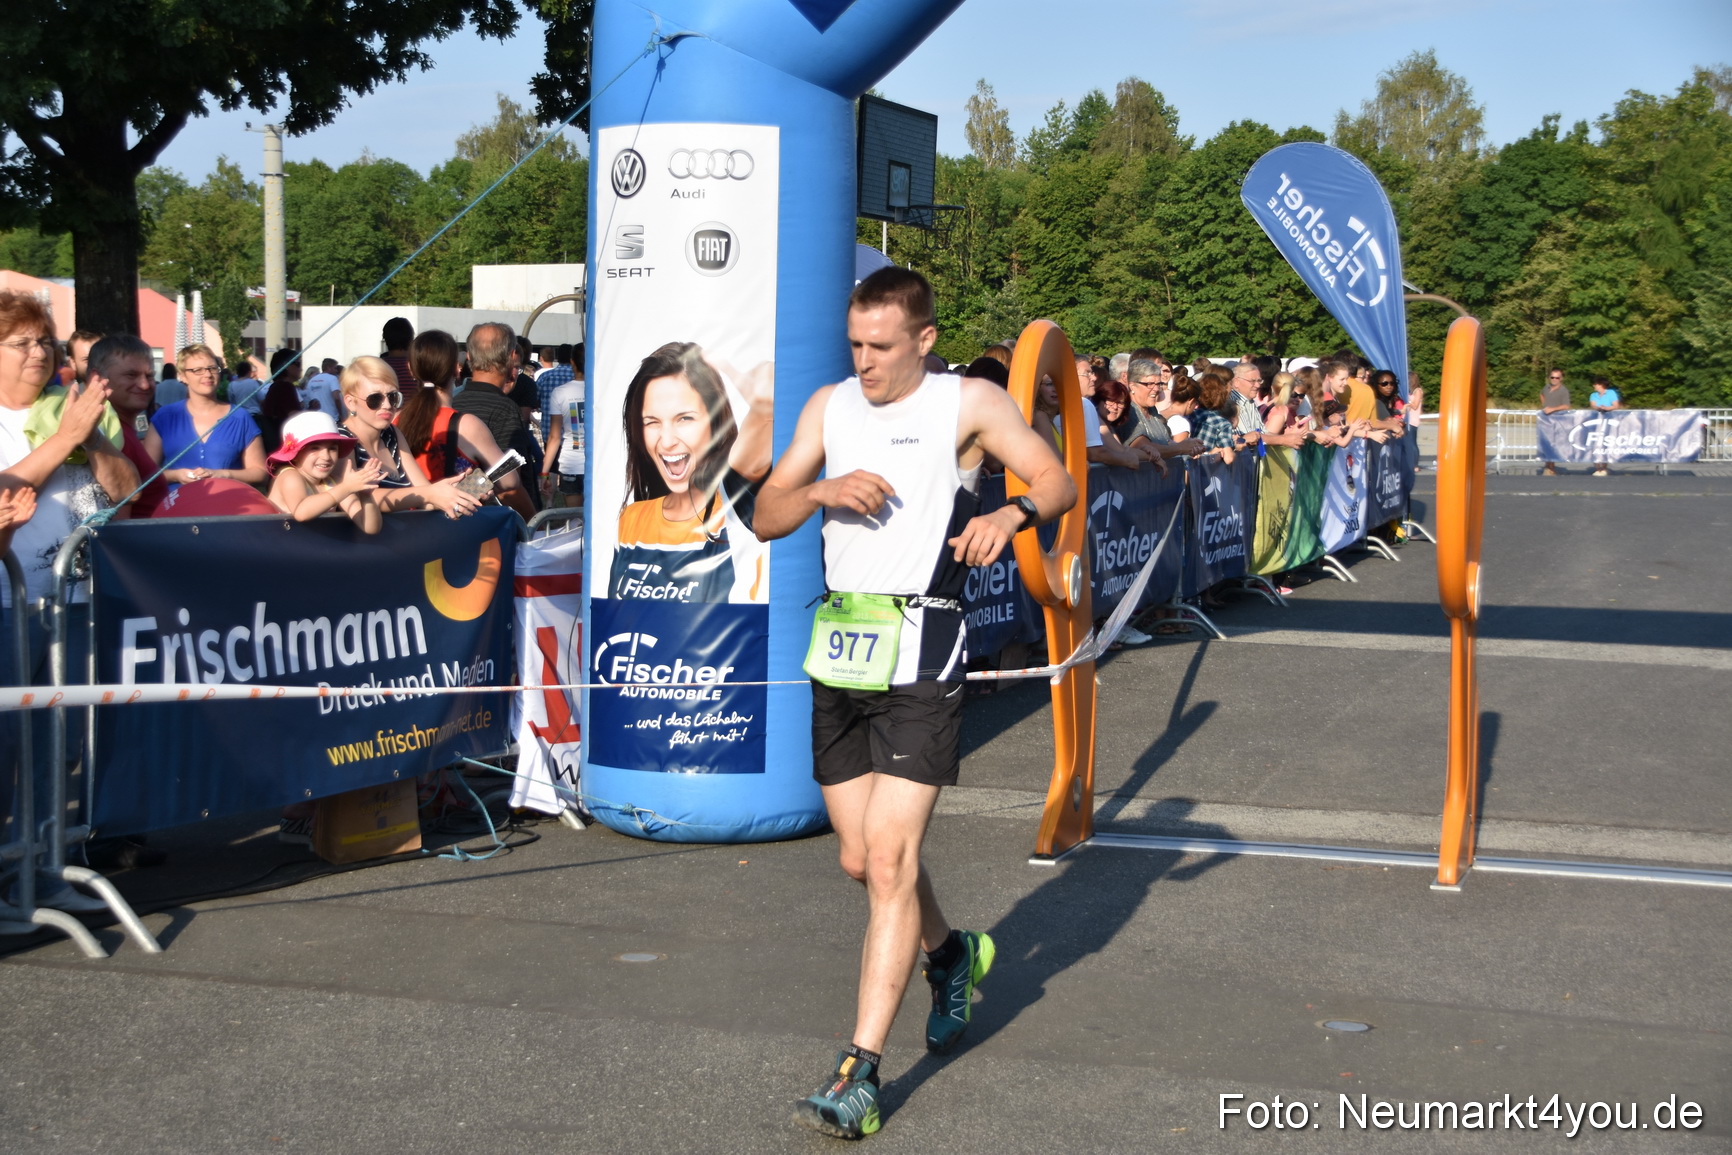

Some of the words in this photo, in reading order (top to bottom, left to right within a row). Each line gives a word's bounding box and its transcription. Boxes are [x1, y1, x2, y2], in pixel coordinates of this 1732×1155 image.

[670, 188, 706, 199] Audi
[698, 237, 728, 262] FIAT
[607, 267, 655, 278] SEAT
[891, 437, 919, 445] Stefan
[1586, 431, 1666, 447] Fischer
[1095, 525, 1158, 574] Fischer
[122, 601, 426, 685] Frischmann
[828, 630, 879, 662] 977
[611, 656, 734, 685] Fischer
[831, 666, 848, 674] Stefan
[318, 672, 386, 715] Druck
[391, 664, 438, 702] und
[442, 655, 494, 688] Medien
[619, 686, 722, 701] AUTOMOBILE
[637, 714, 662, 730] und
[665, 711, 692, 727] das
[713, 727, 748, 741] mit!
